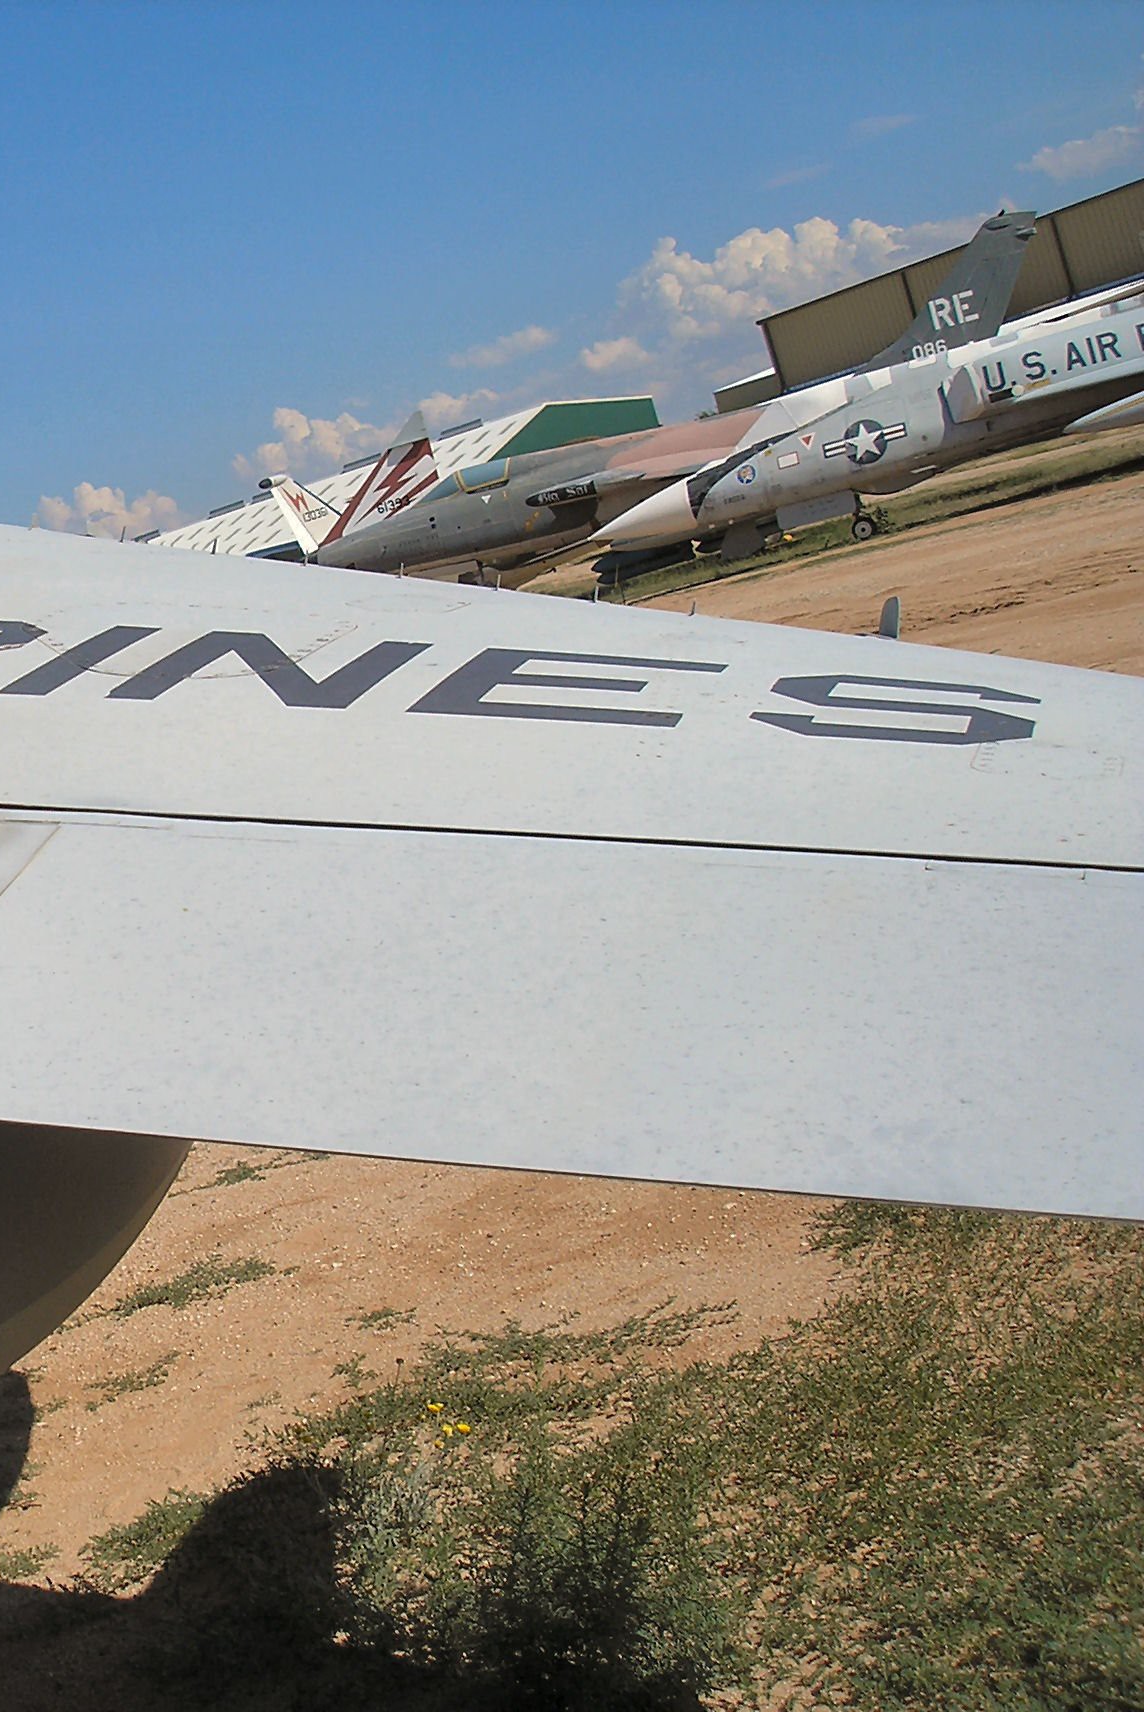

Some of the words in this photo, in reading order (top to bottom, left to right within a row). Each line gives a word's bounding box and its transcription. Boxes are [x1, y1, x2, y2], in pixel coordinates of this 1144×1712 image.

[928, 289, 980, 331] RE
[912, 339, 948, 360] 086
[1066, 332, 1122, 371] AIR
